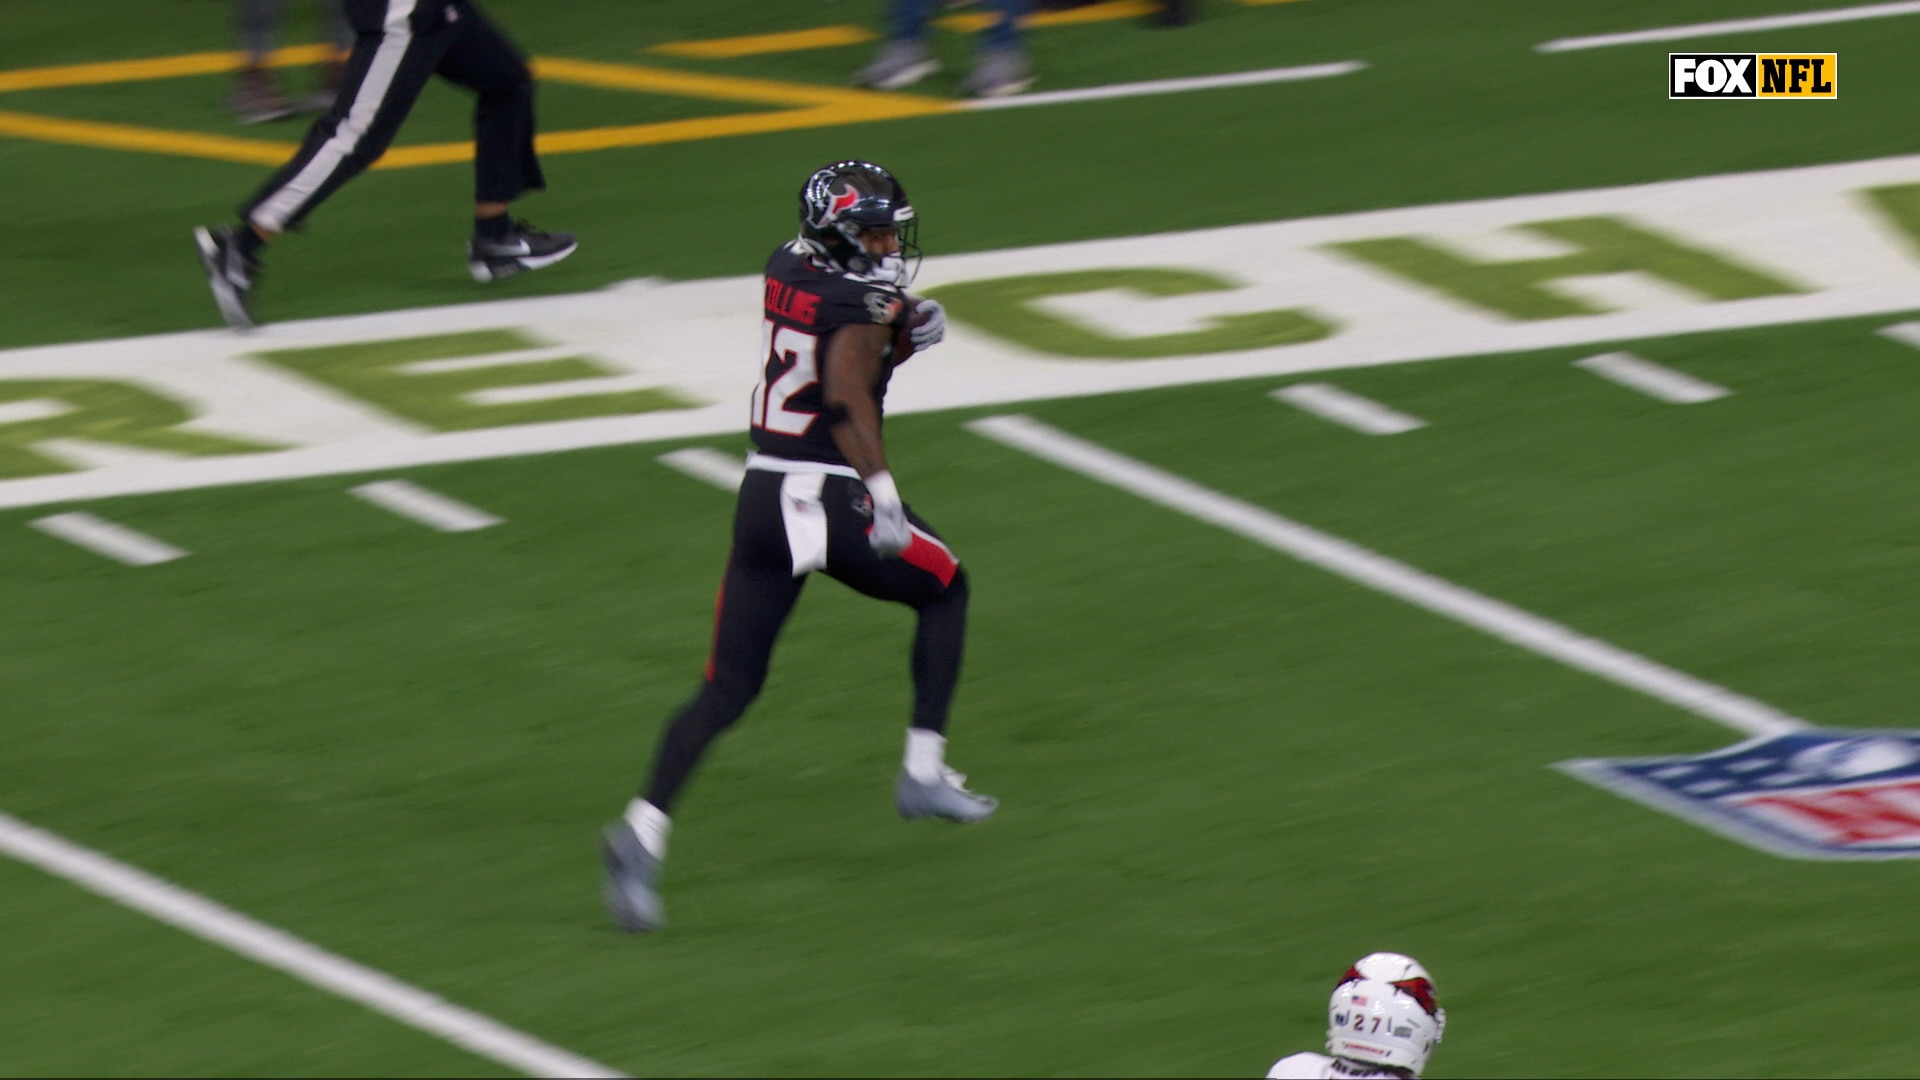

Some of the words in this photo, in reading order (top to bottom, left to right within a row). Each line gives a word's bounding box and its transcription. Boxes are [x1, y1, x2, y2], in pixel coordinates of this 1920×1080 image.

[914, 183, 1920, 360] CH
[752, 319, 821, 438] 12
[1353, 1013, 1382, 1034] 27
